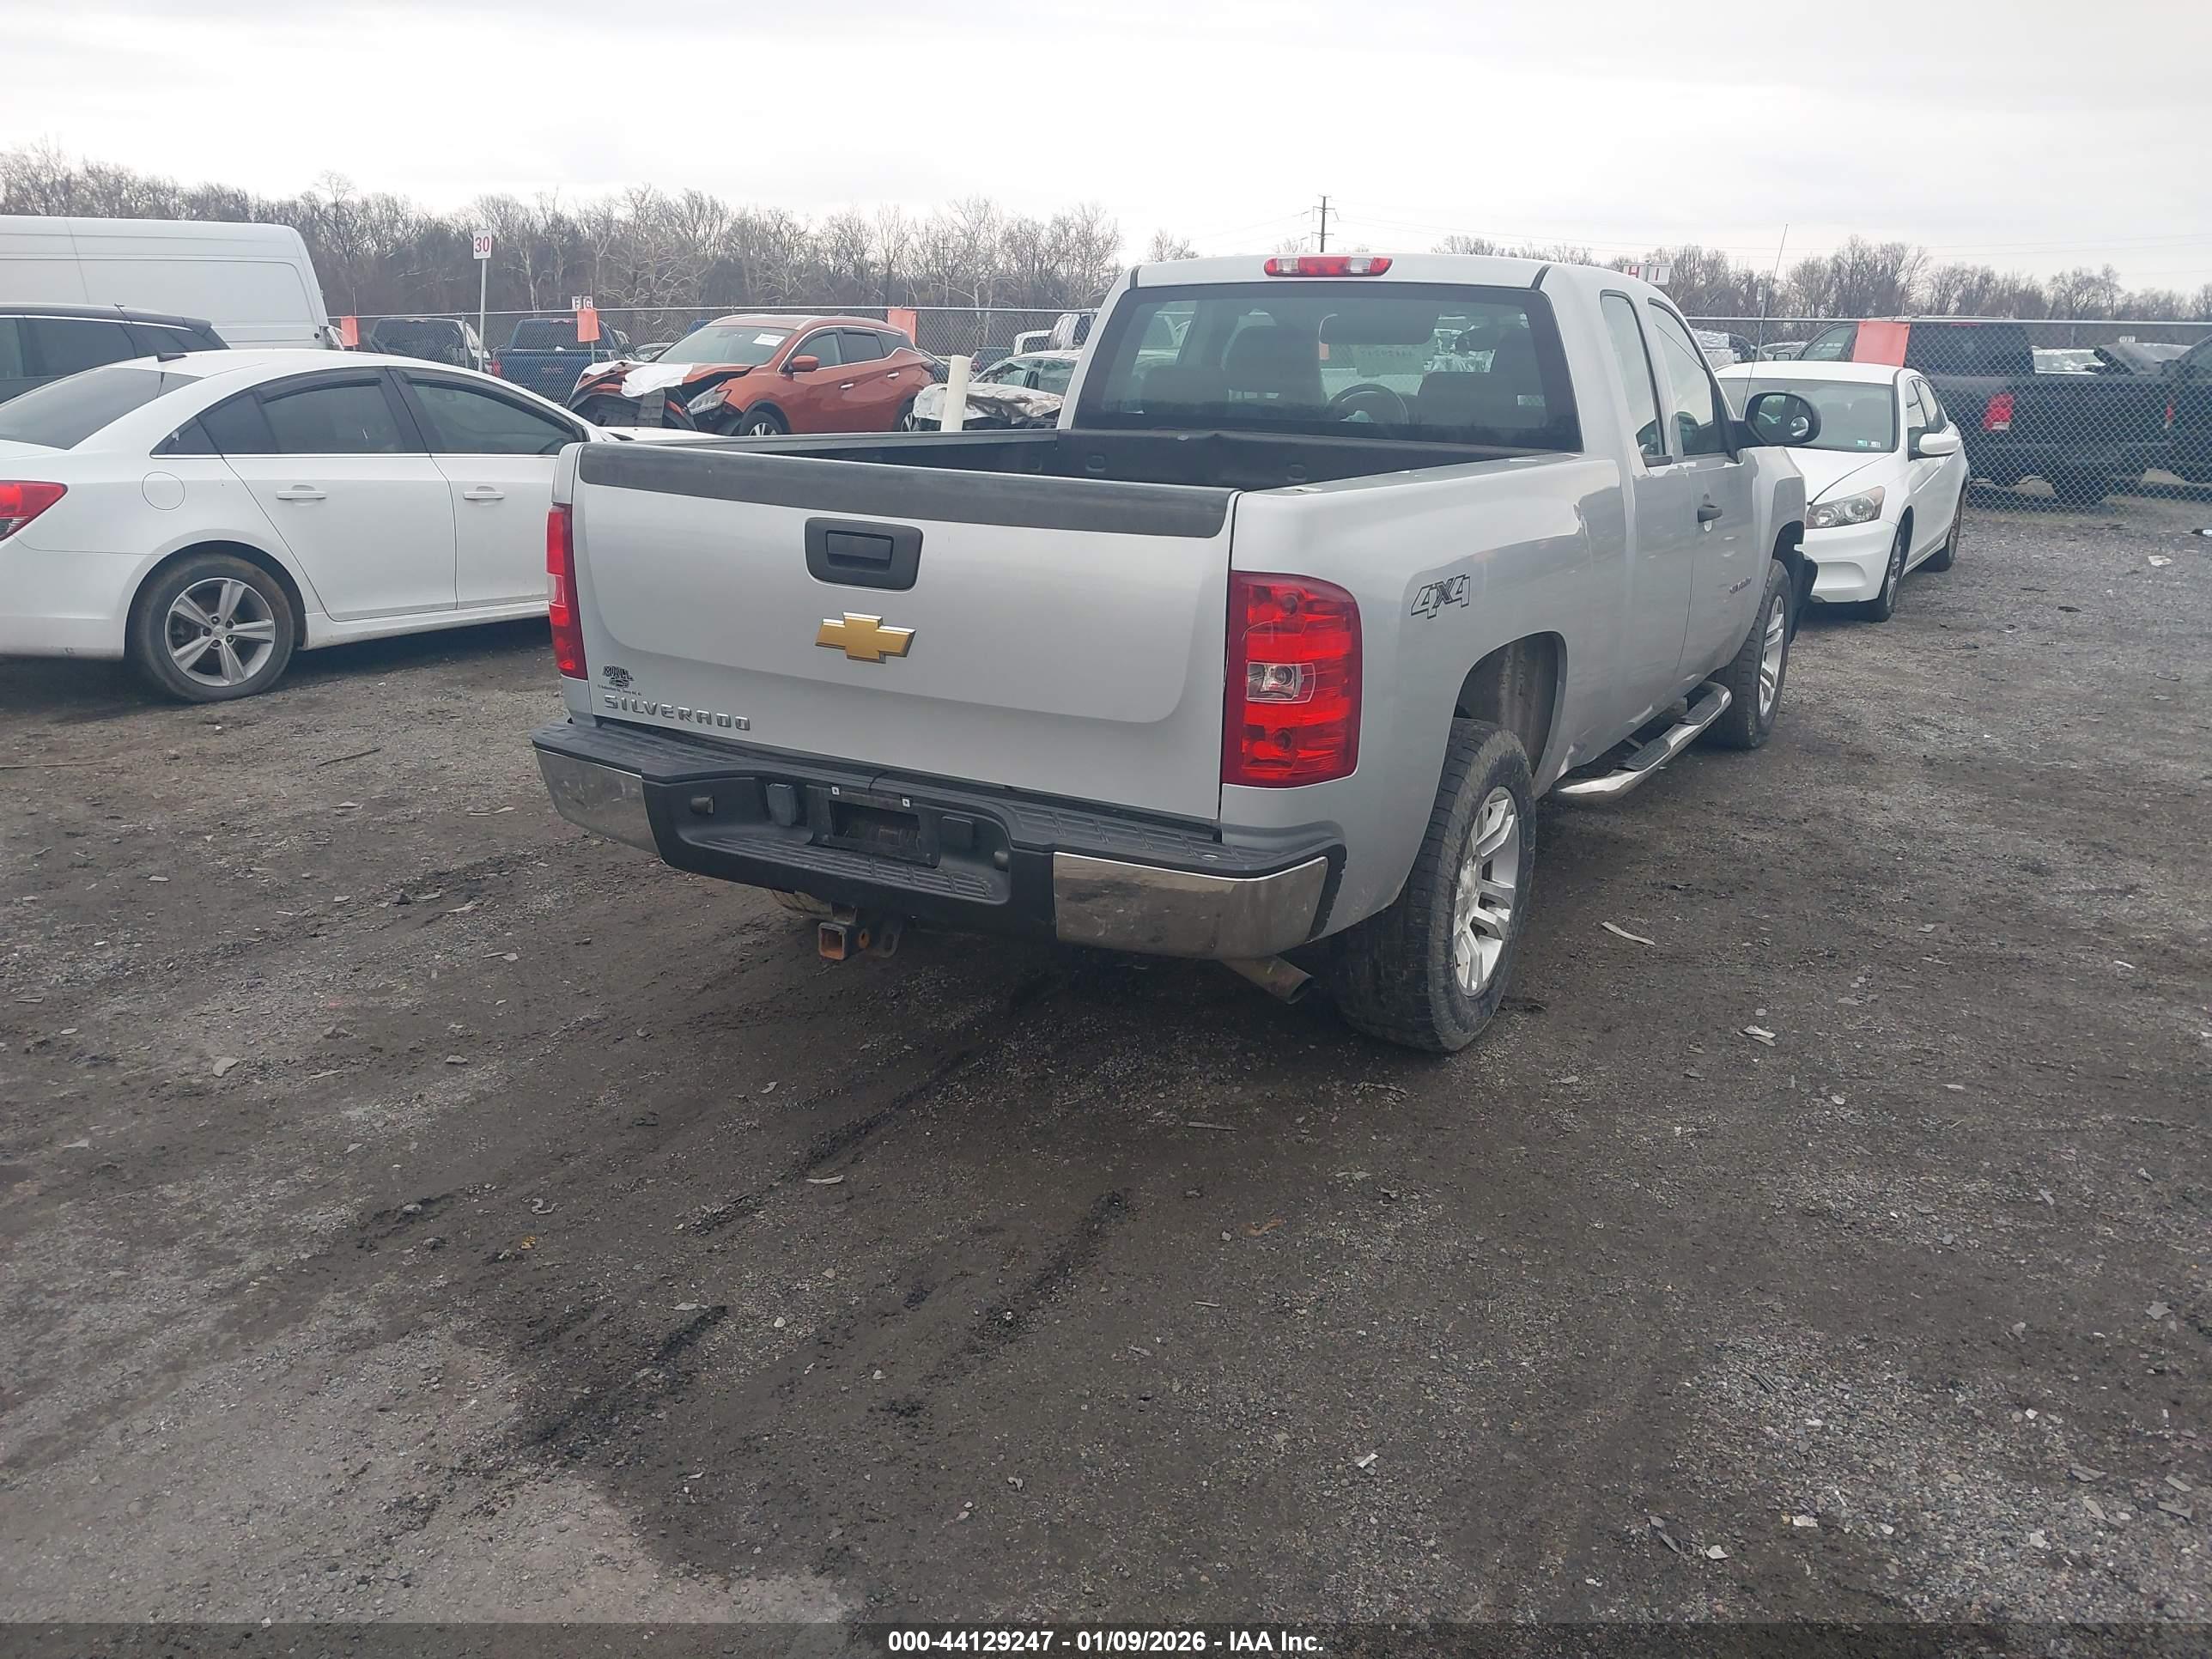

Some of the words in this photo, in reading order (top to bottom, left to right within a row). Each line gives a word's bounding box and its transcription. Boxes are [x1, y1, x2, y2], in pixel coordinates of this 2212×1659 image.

[475, 235, 490, 253] 30
[1627, 265, 1640, 279] H
[604, 695, 750, 731] SILVERADO
